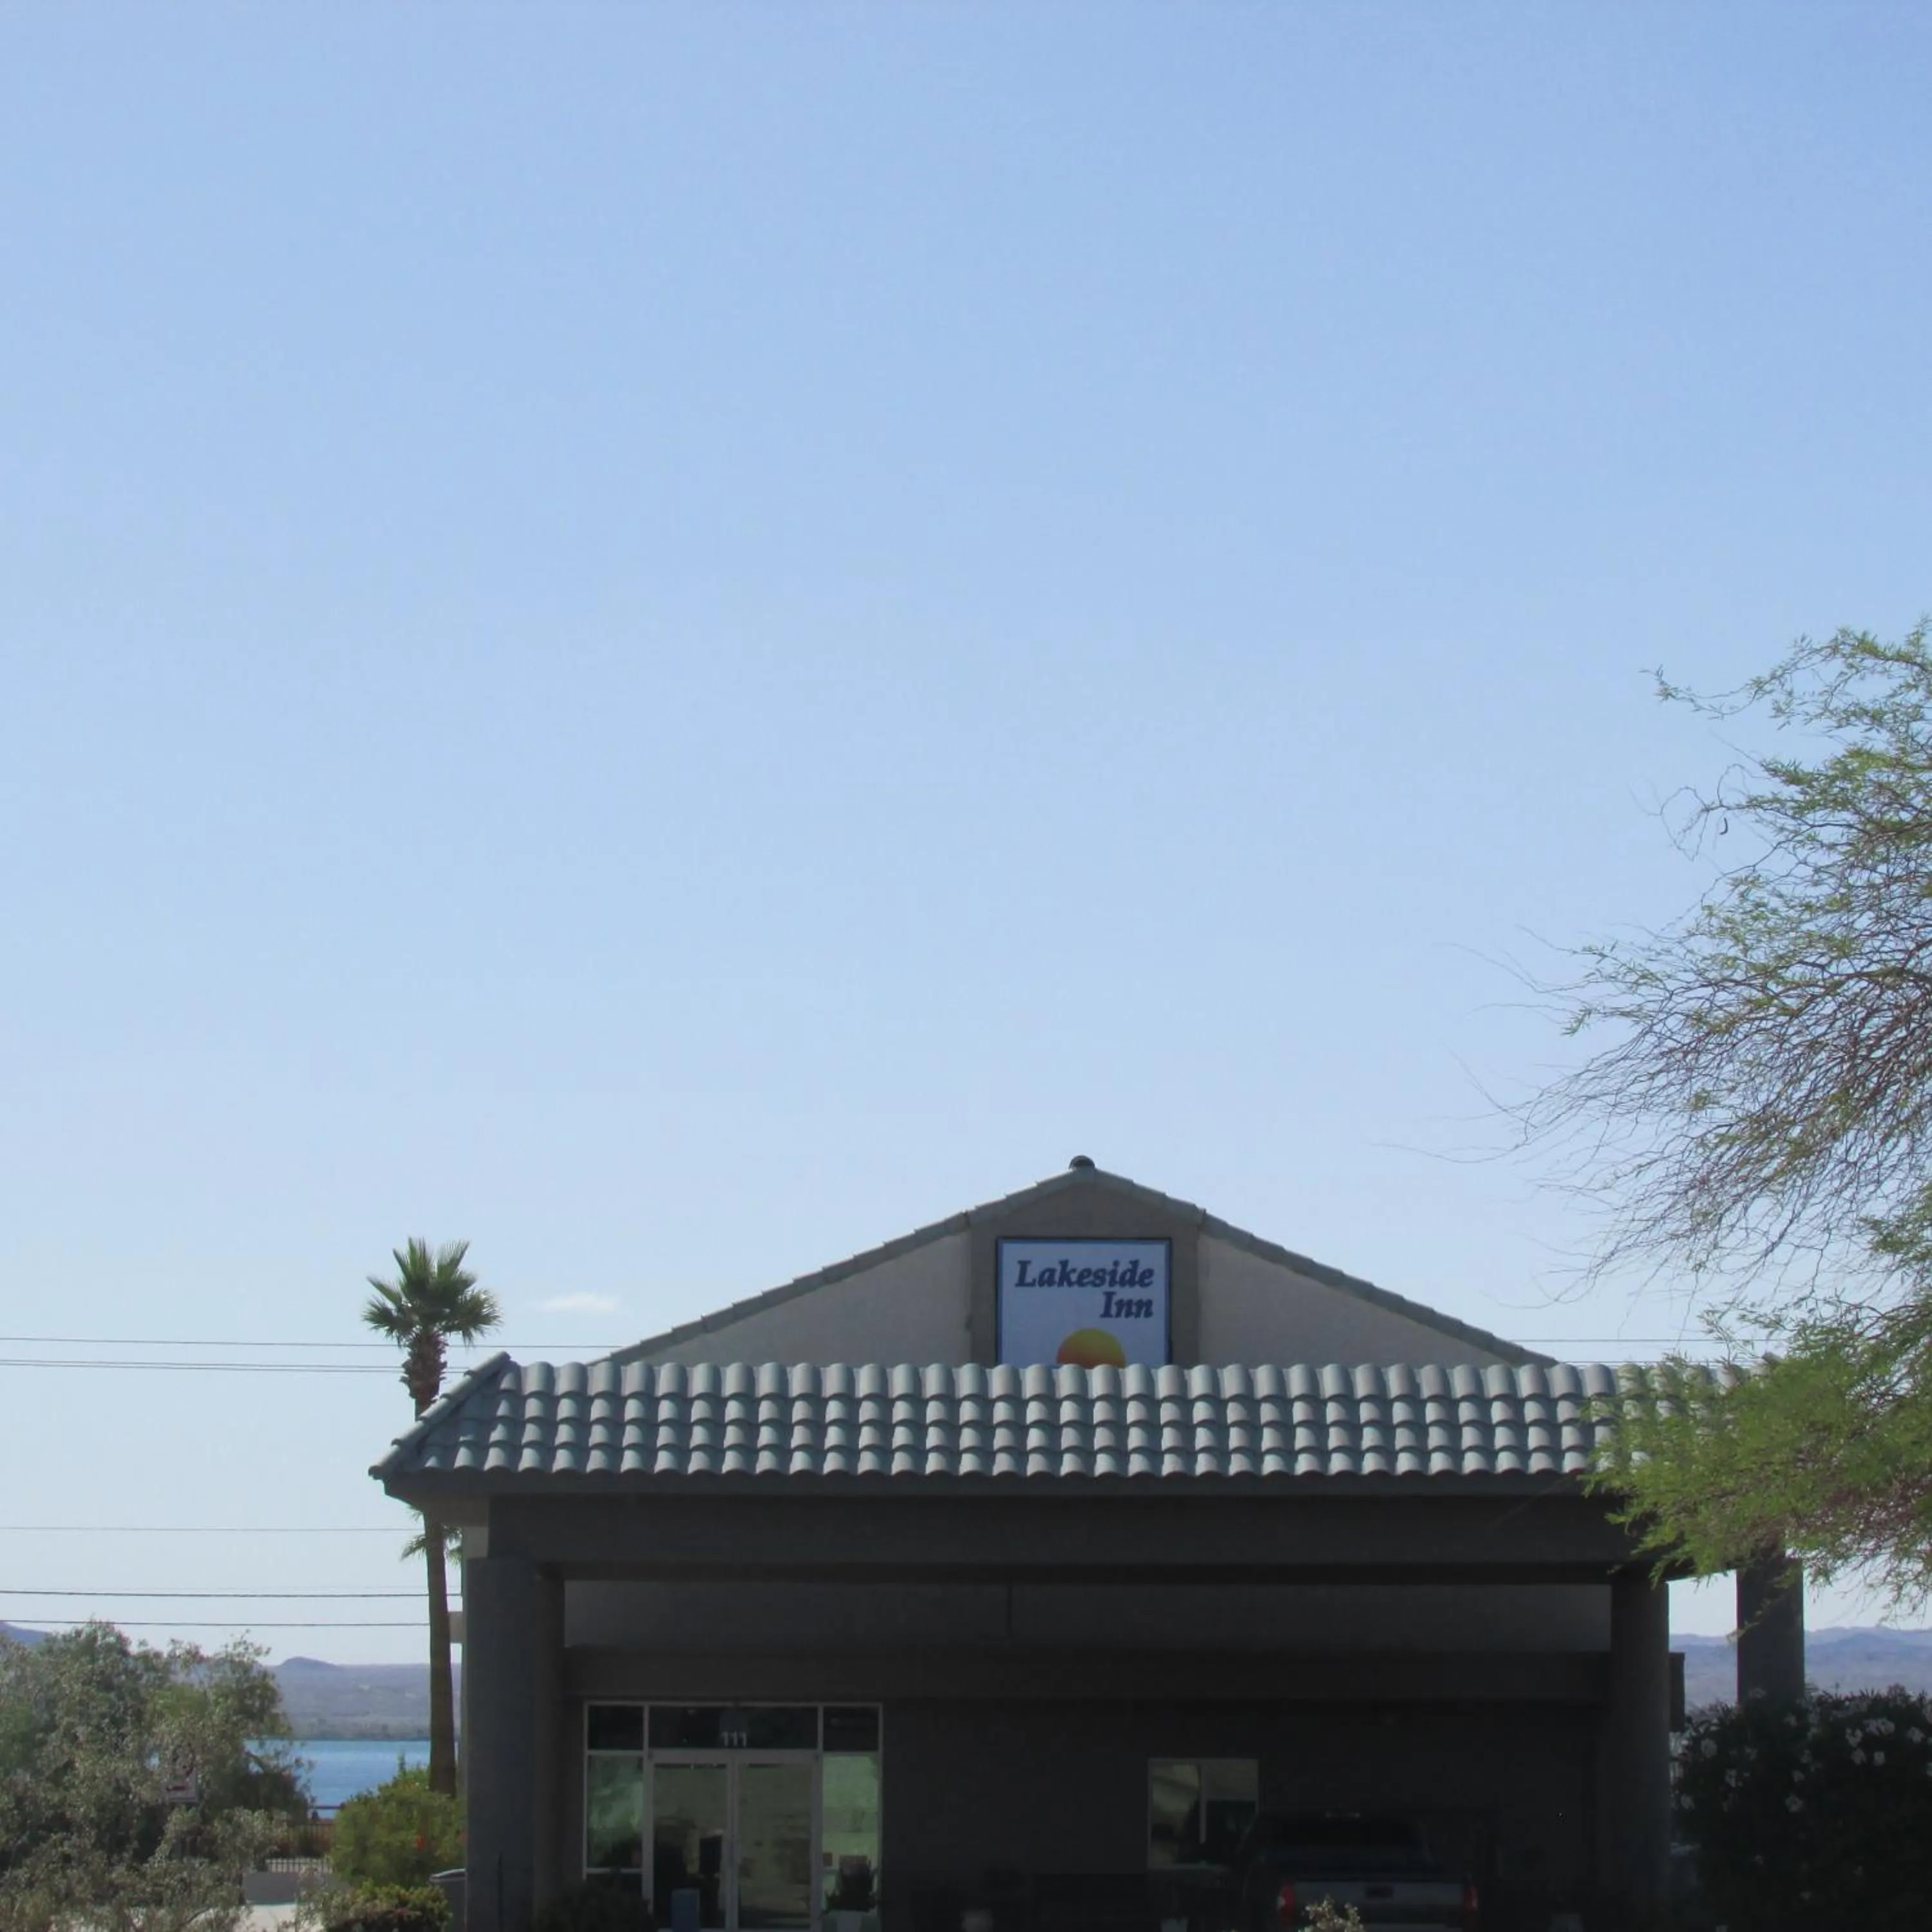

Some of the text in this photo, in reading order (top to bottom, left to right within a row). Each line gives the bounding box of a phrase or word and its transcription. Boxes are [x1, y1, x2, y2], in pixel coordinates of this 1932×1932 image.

[1014, 1258, 1155, 1287] Lakeside
[1099, 1291, 1153, 1318] Inn
[721, 1730, 747, 1747] 111
